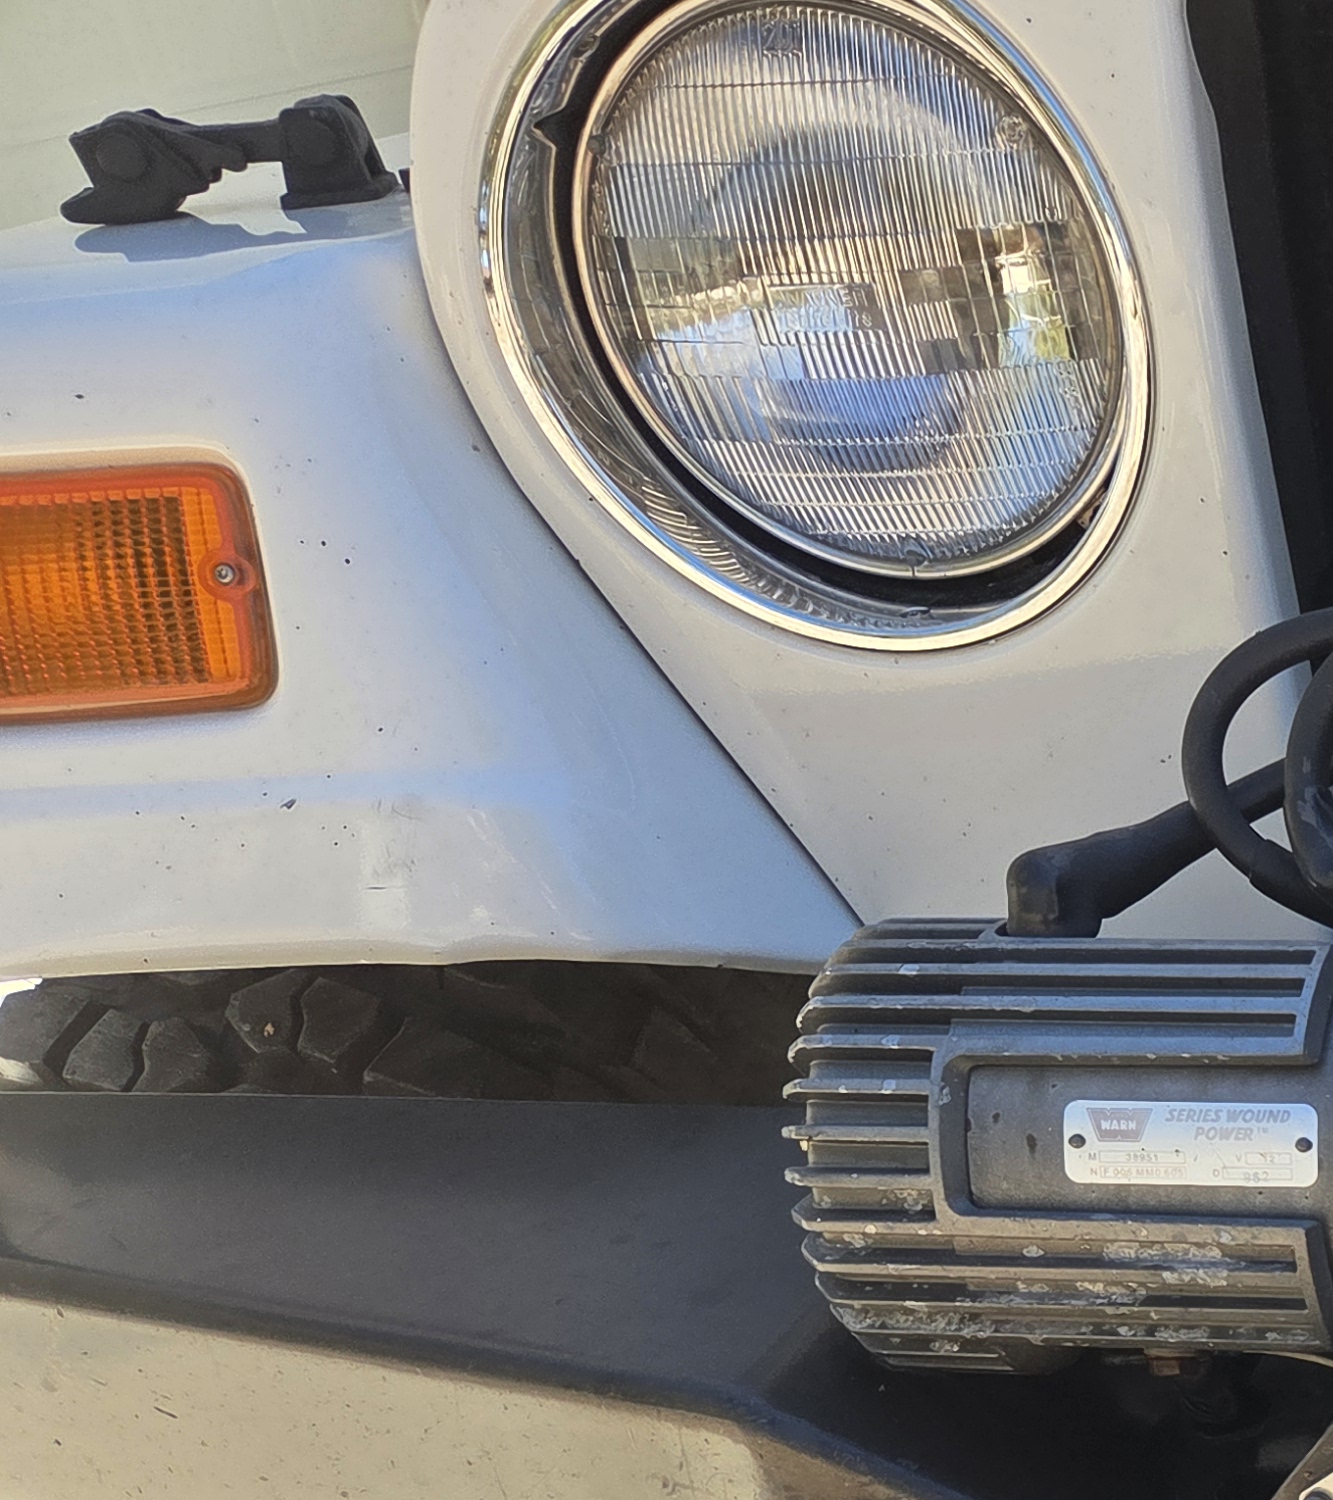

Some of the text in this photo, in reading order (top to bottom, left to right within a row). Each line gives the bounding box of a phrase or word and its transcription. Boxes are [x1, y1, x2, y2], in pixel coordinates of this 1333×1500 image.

[1165, 1108, 1291, 1124] SERIES WOUND
[1100, 1119, 1137, 1131] WARN
[1088, 1152, 1097, 1161] M
[1235, 1154, 1242, 1162] V
[1090, 1167, 1098, 1176] N
